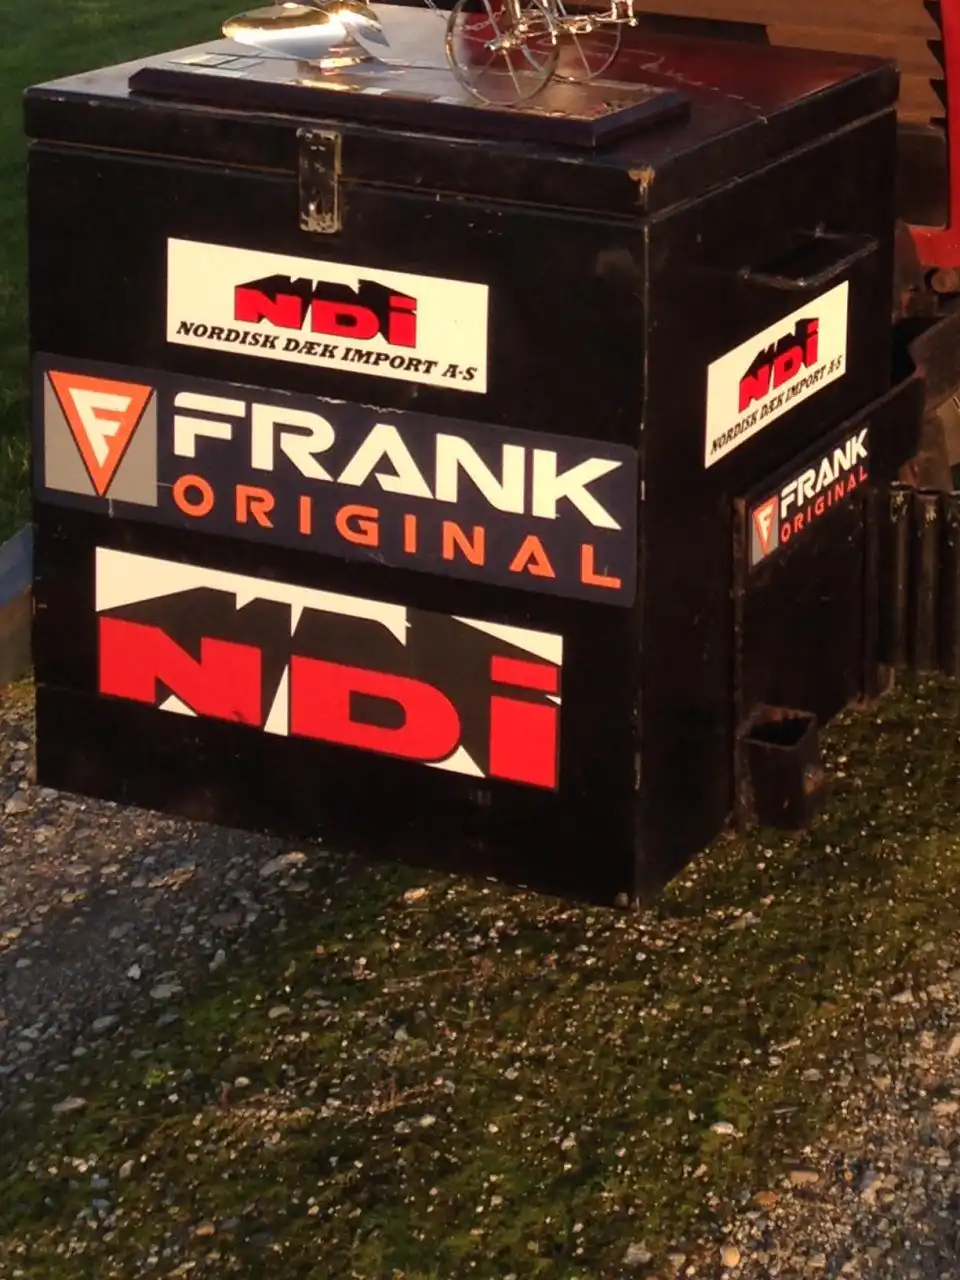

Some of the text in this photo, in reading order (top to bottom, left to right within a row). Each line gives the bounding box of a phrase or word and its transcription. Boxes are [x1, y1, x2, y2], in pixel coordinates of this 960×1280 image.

[176, 320, 279, 350] NORDISK
[281, 337, 338, 360] DÆK
[341, 347, 438, 378] IMPORT
[710, 409, 759, 455] NORDISK
[785, 365, 827, 402] IMPORT
[173, 392, 623, 531] FRANK
[780, 427, 868, 519] FRANK
[780, 465, 868, 543] ORIGINAL
[172, 474, 622, 590] ORIGINAL
